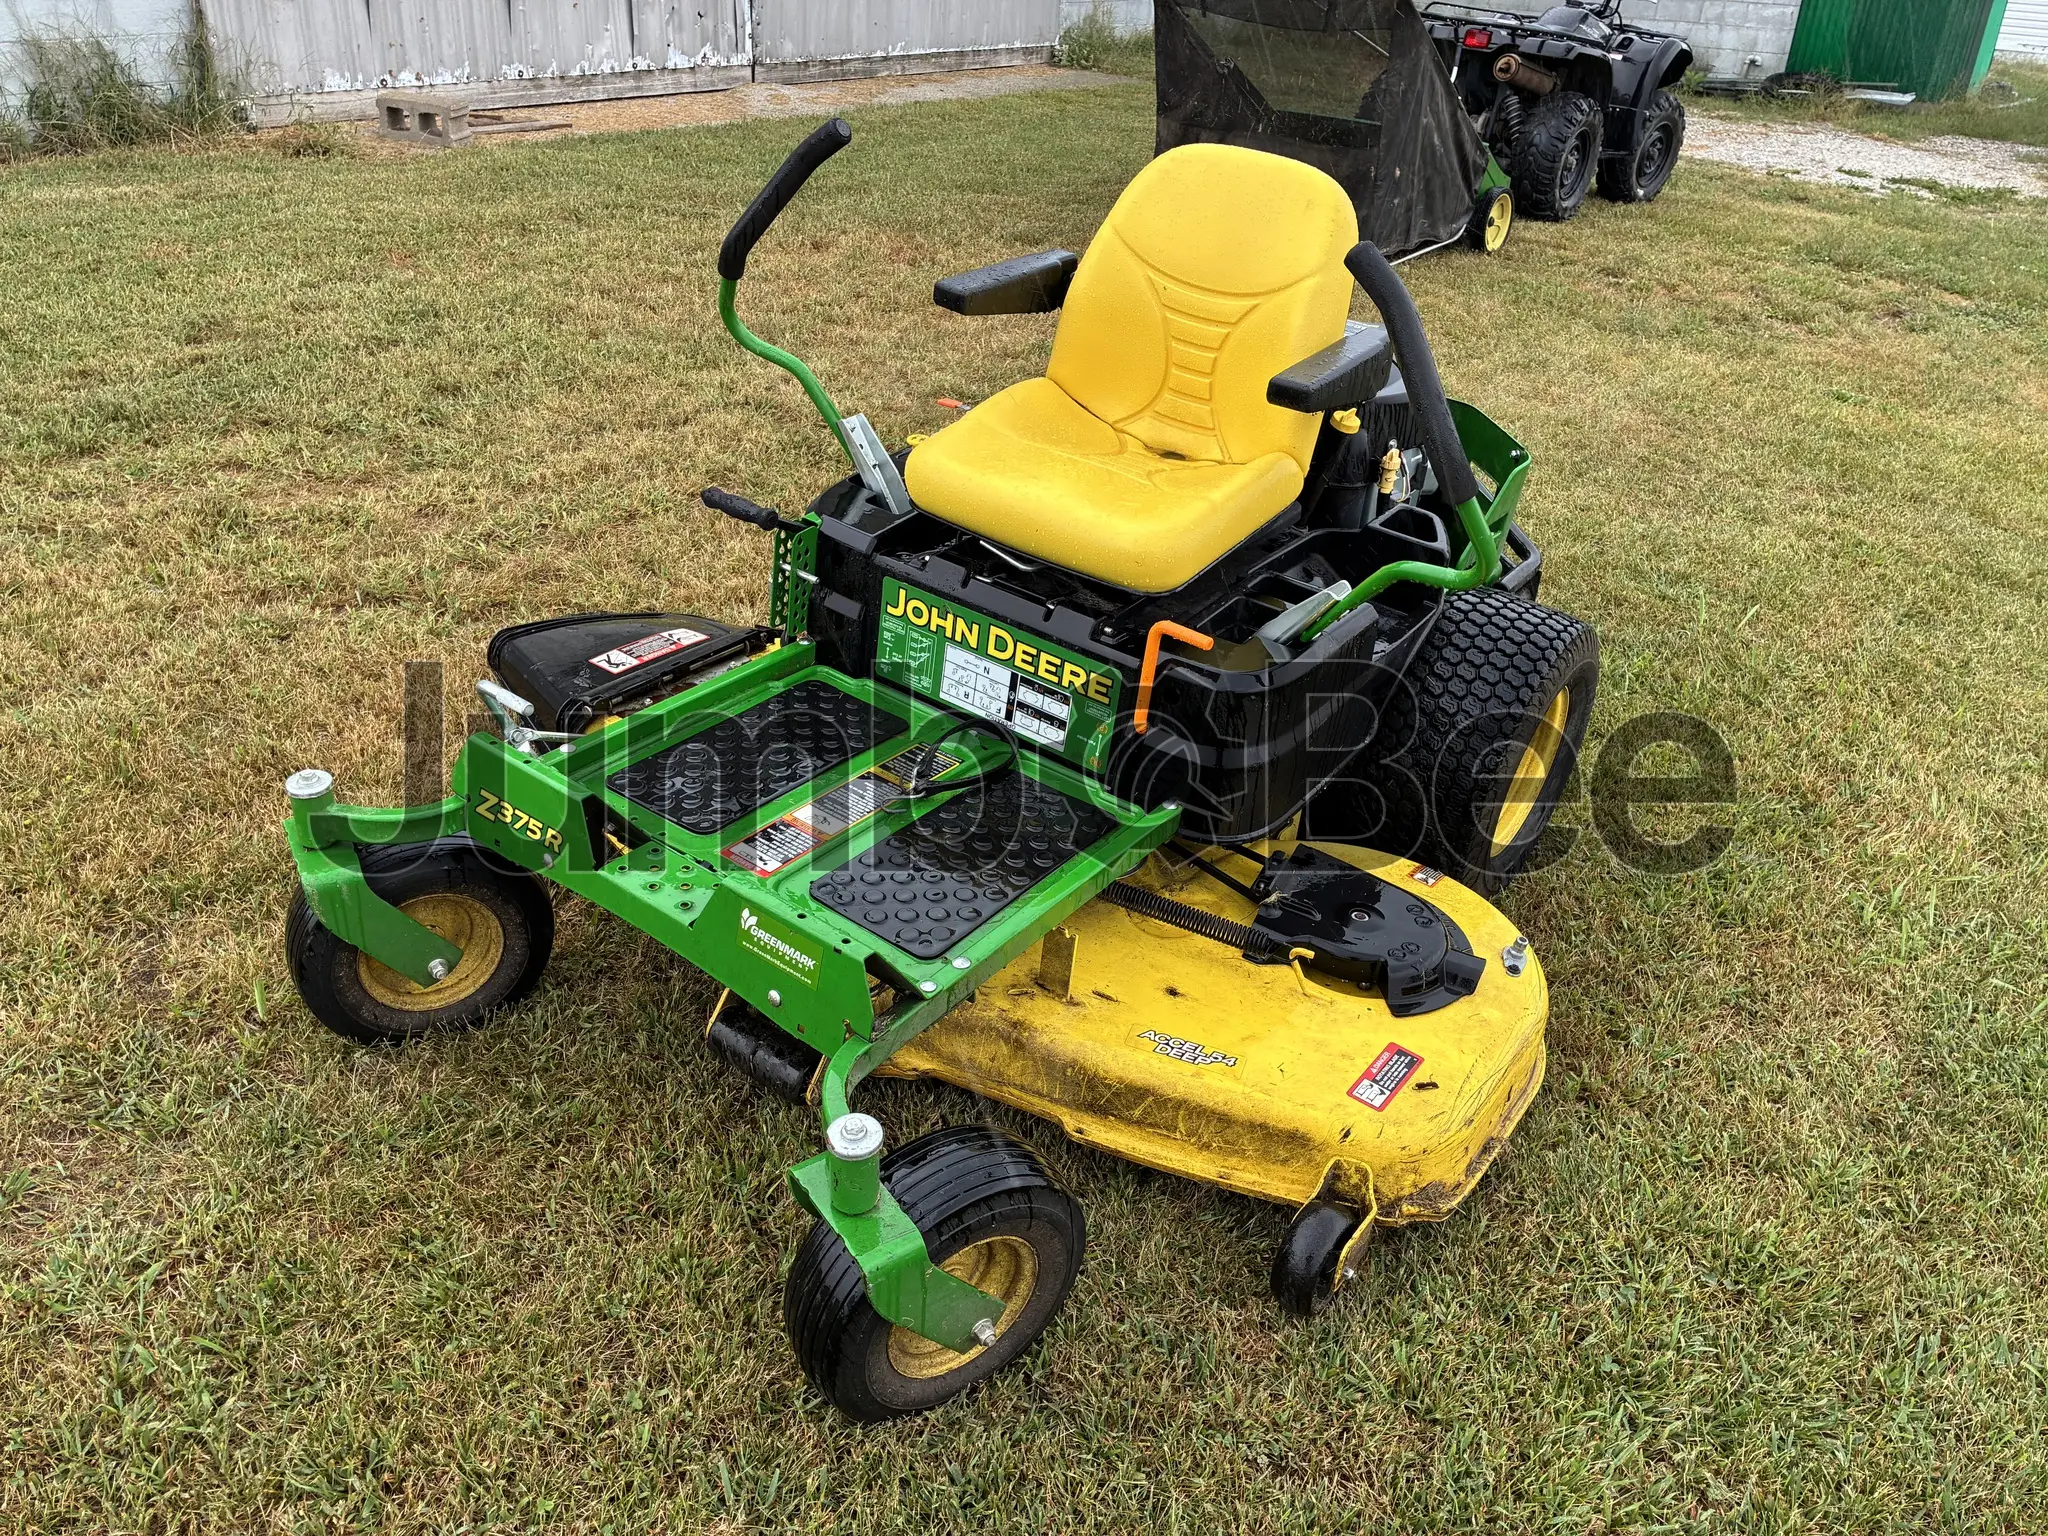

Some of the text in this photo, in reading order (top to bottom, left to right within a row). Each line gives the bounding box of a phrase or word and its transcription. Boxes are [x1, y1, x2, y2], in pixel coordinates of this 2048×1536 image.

[886, 588, 1115, 704] JOHN DEERE
[983, 665, 990, 675] N
[963, 690, 969, 699] R
[995, 705, 1001, 714] F
[750, 925, 817, 971] GREENMARK
[753, 937, 810, 972] EQUIPMENT
[1137, 1029, 1238, 1067] ACCEL 54
[1153, 1042, 1213, 1065] DEEP
[1373, 1051, 1390, 1069] DANGER
